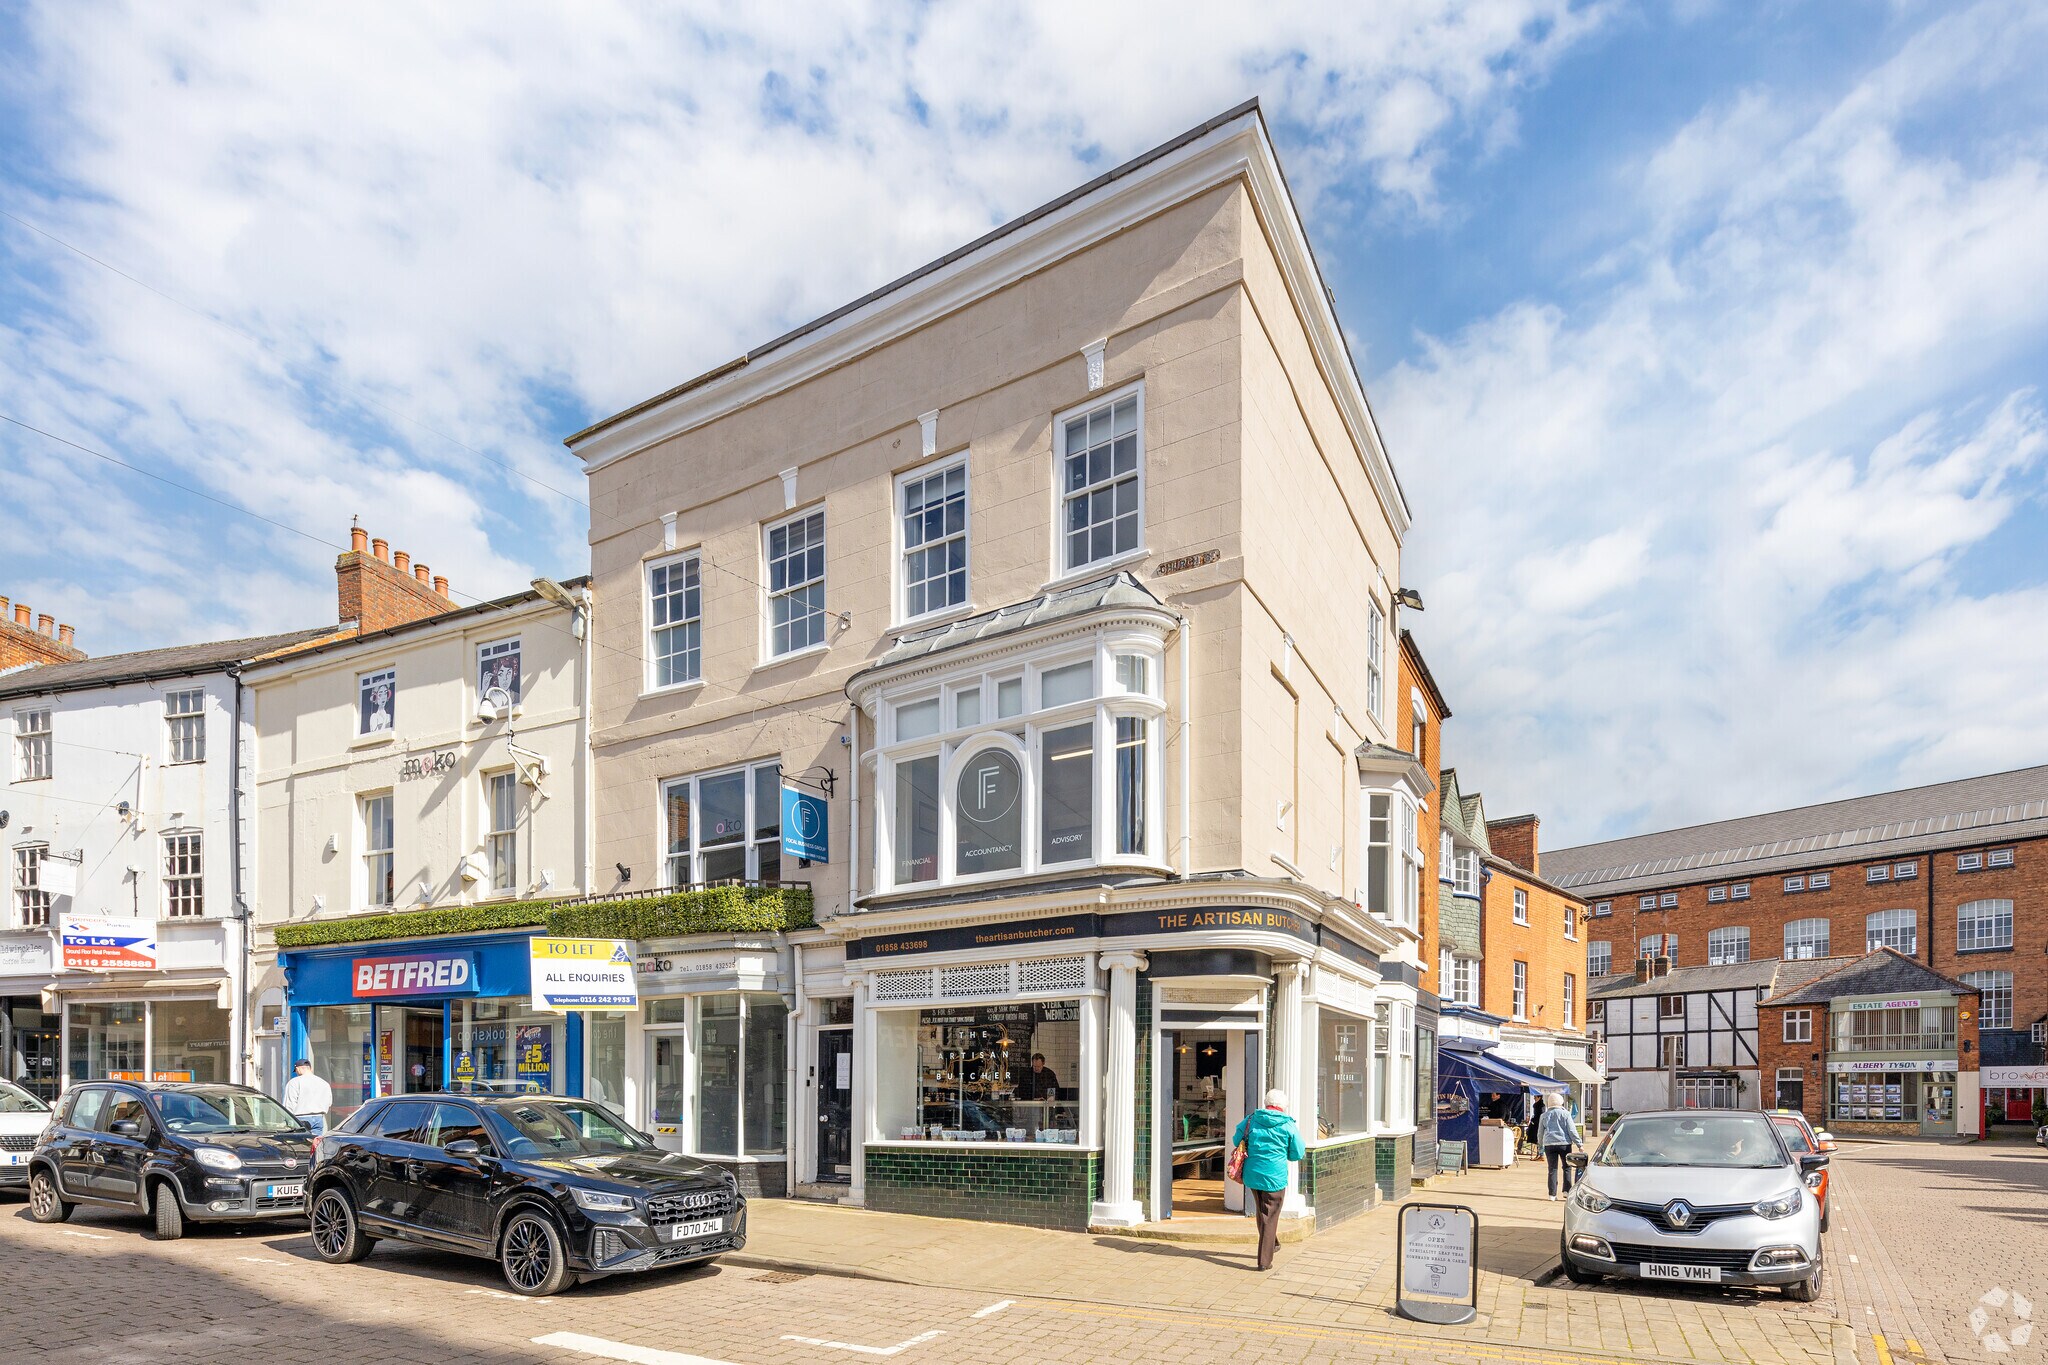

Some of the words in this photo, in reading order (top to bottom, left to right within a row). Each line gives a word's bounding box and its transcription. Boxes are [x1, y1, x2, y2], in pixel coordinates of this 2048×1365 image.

[1160, 555, 1199, 573] CHURCH
[403, 750, 456, 775] moko
[1051, 833, 1083, 845] ADVISORY
[964, 844, 1013, 858] ACCOUNTANCY
[902, 857, 932, 867] FINANCIAL
[1158, 914, 1188, 929] THE
[1192, 911, 1263, 926] ARTISAN
[975, 926, 1075, 943] theartisanbutcher.com
[66, 937, 87, 945] To
[91, 937, 116, 946] Let
[875, 942, 899, 953] 01858
[900, 940, 928, 951] 433698
[547, 943, 568, 954] TO
[572, 943, 595, 955] LET
[68, 958, 99, 966] 0116
[356, 958, 469, 990] BETFRED
[546, 973, 566, 982] ALL
[568, 973, 625, 983] ENQUIRIES
[1852, 1002, 1883, 1010] ESTATE
[1885, 1000, 1919, 1008] AGENTS
[959, 1030, 987, 1039] THE
[525, 1044, 542, 1063] £5
[937, 1051, 1009, 1060] ARTISAN
[518, 1063, 550, 1073] MILLION
[936, 1072, 1011, 1081] BUTCHER
[276, 1185, 299, 1196] KU15
[676, 1223, 700, 1237] FD70
[702, 1220, 719, 1233] ZHL
[1649, 1264, 1680, 1277] HN16
[1684, 1267, 1712, 1279] VMH
